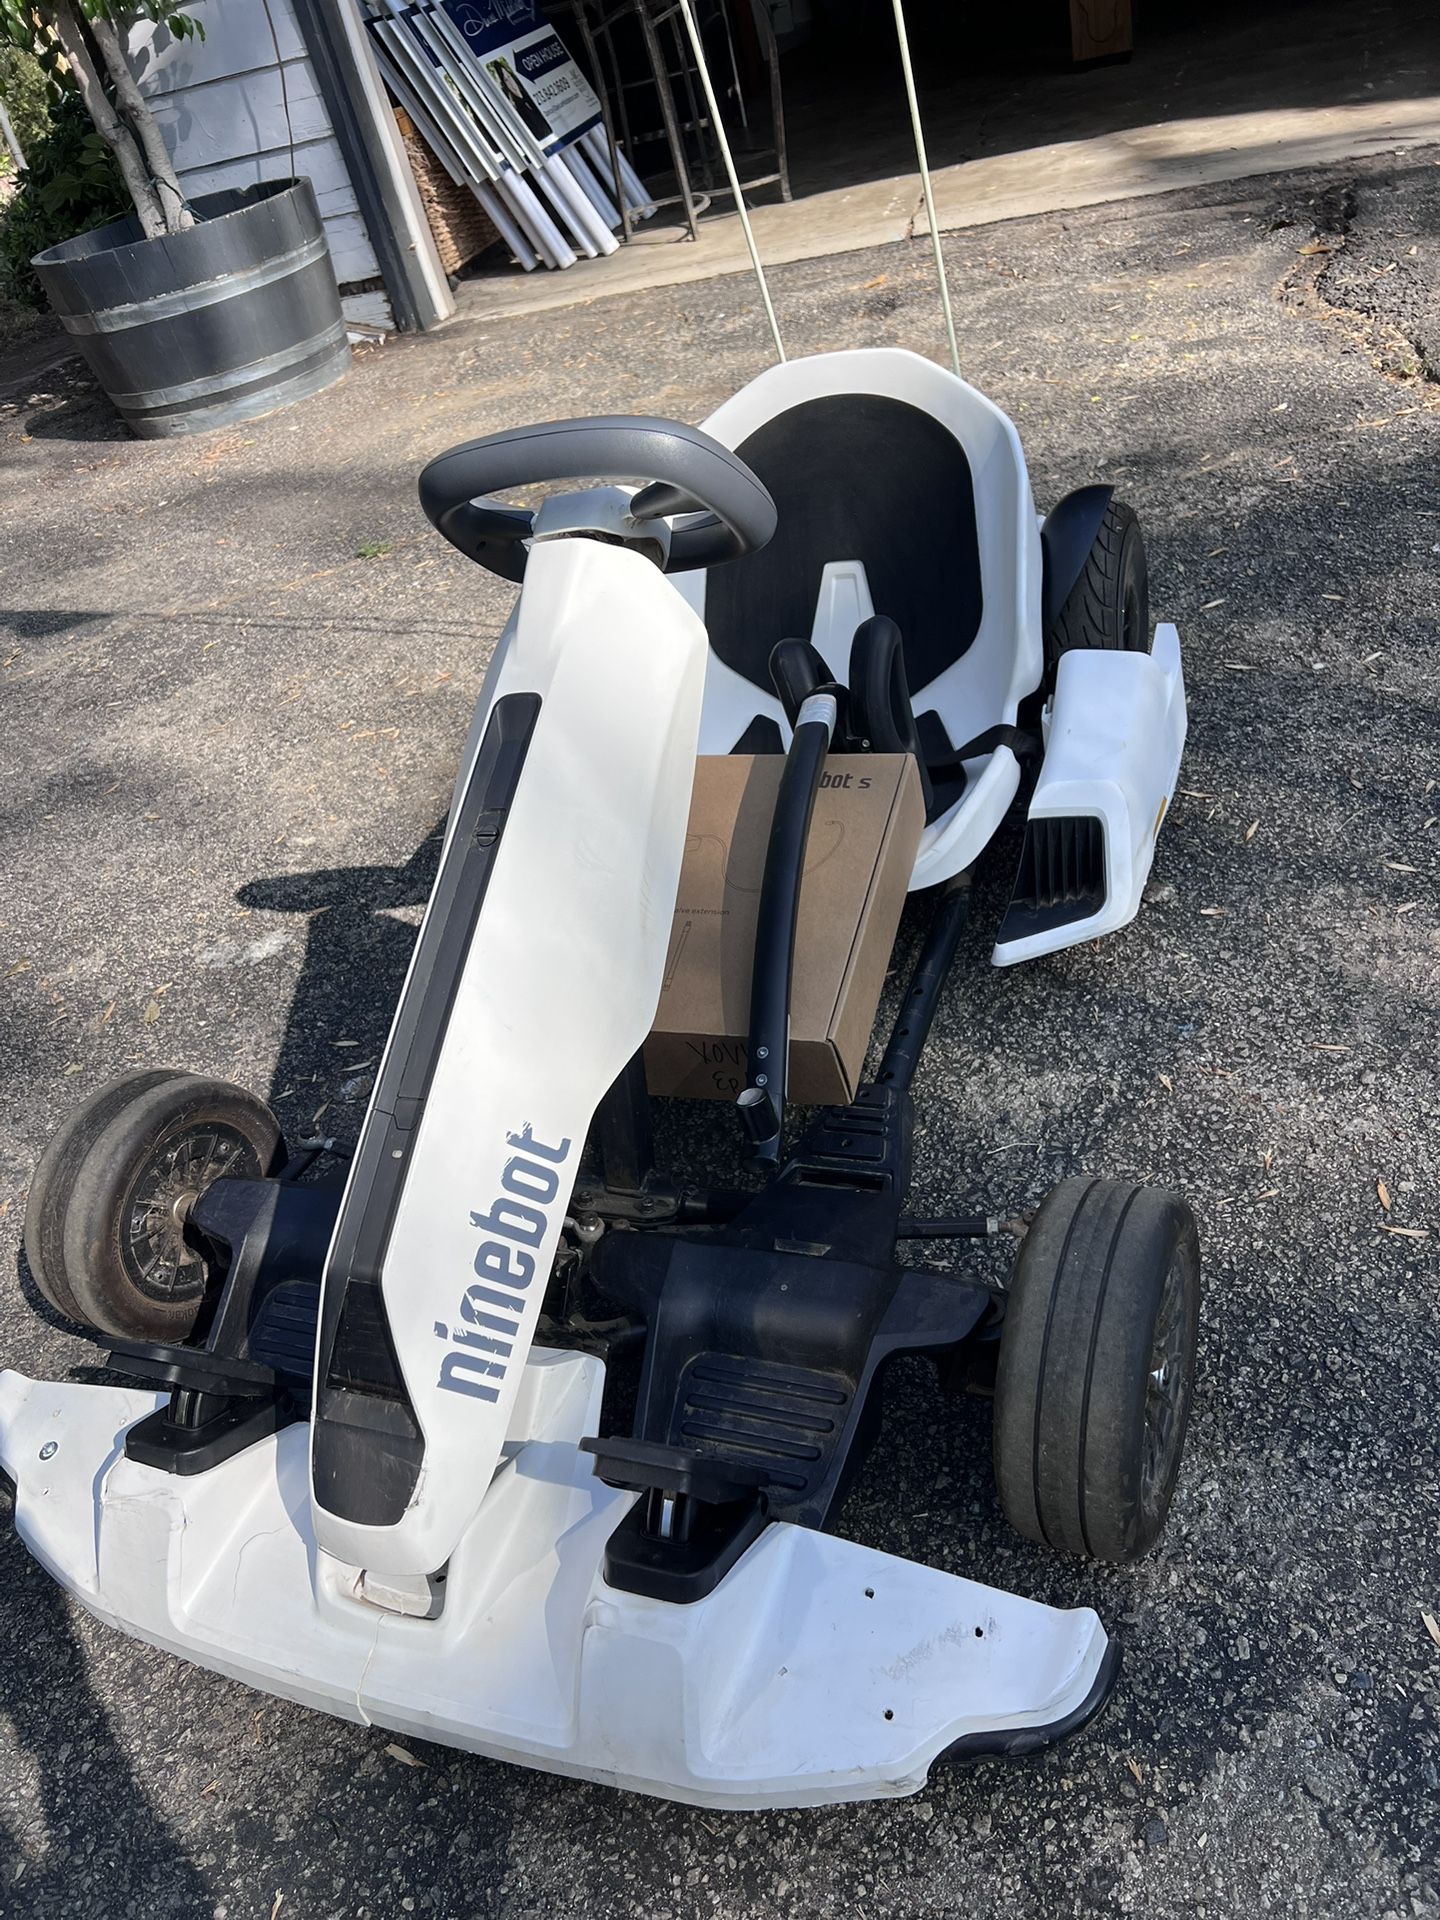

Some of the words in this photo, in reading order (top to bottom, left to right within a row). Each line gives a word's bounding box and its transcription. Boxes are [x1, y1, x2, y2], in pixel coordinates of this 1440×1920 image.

[521, 50, 544, 71] OPEN
[539, 42, 564, 62] HOUSE
[819, 771, 853, 789] bot
[690, 908, 730, 916] extension
[434, 1120, 572, 1403] ninebot
